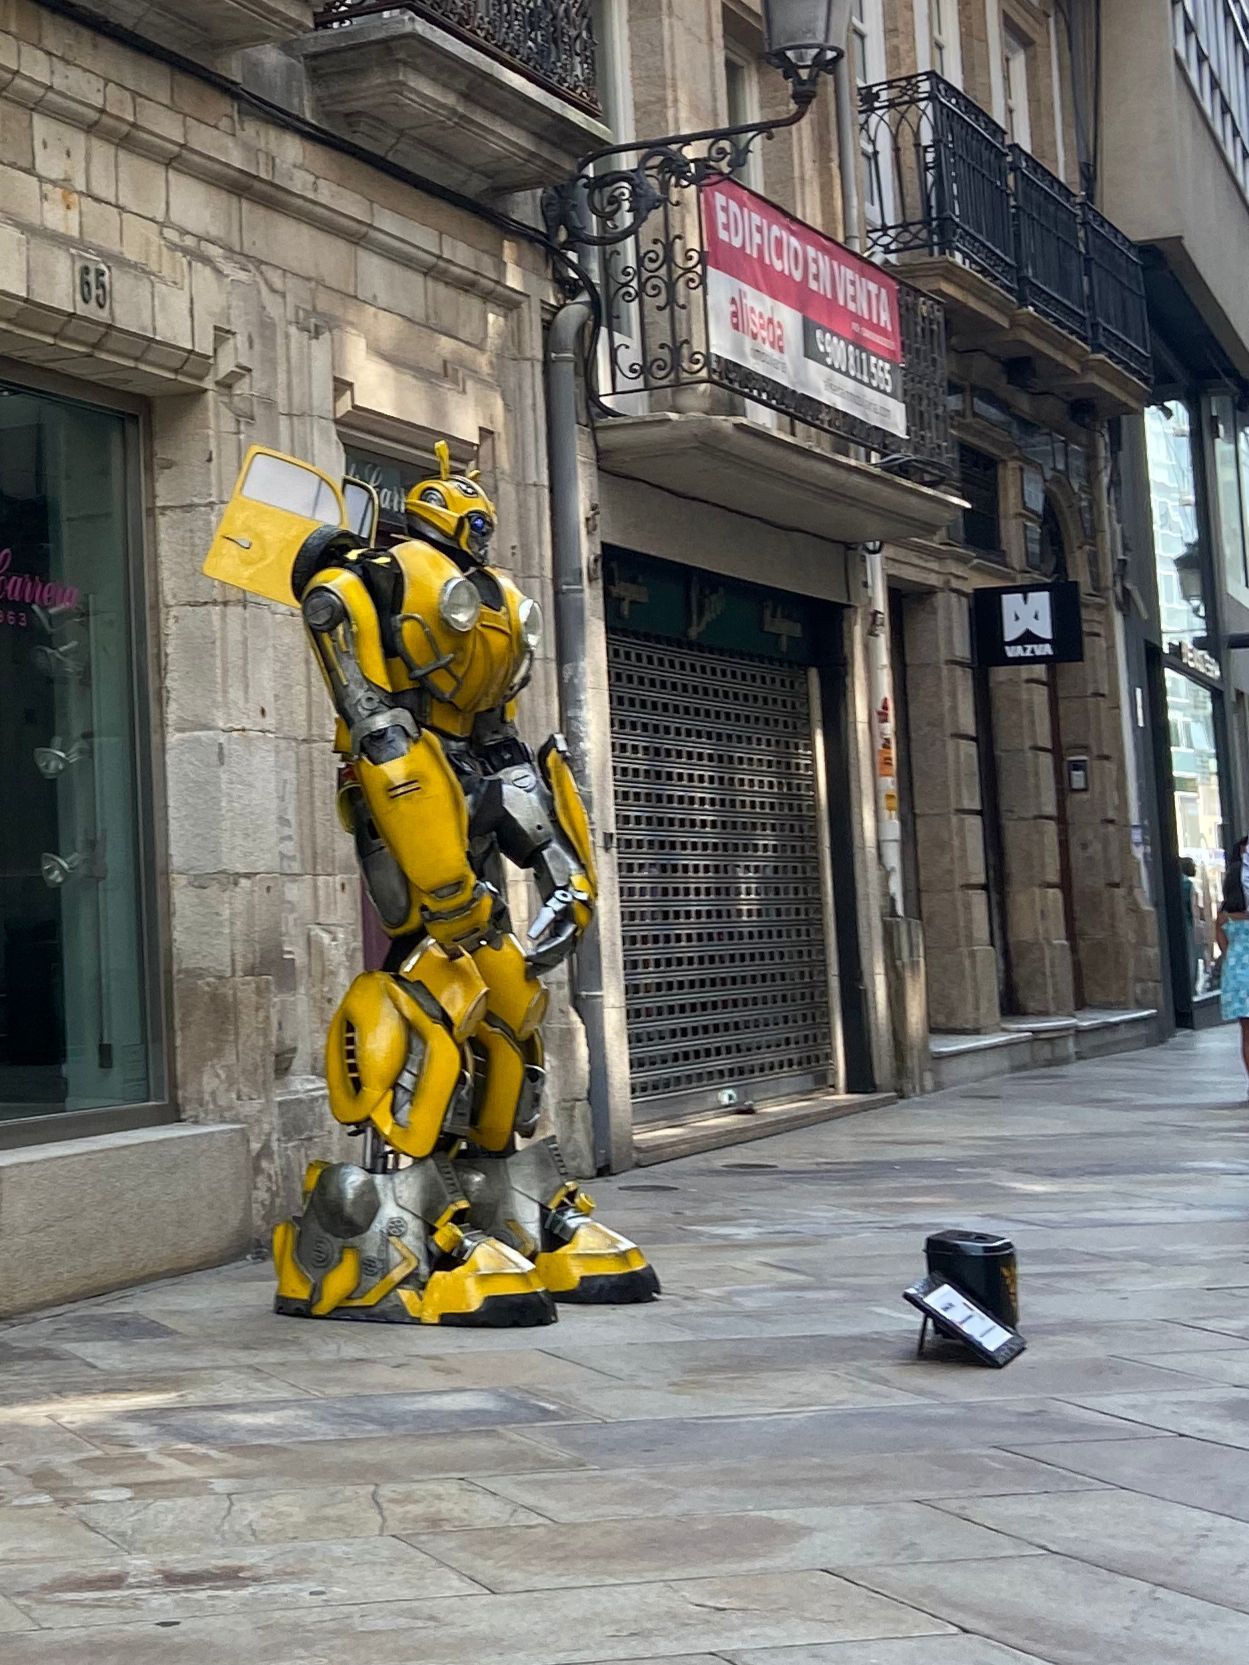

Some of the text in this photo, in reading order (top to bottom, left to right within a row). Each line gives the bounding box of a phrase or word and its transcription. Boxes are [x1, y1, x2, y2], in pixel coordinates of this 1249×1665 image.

[80, 264, 107, 309] 65
[714, 191, 892, 332] EDIFICIO EN VENTA
[729, 288, 785, 354] aliseda
[825, 332, 847, 372] 900
